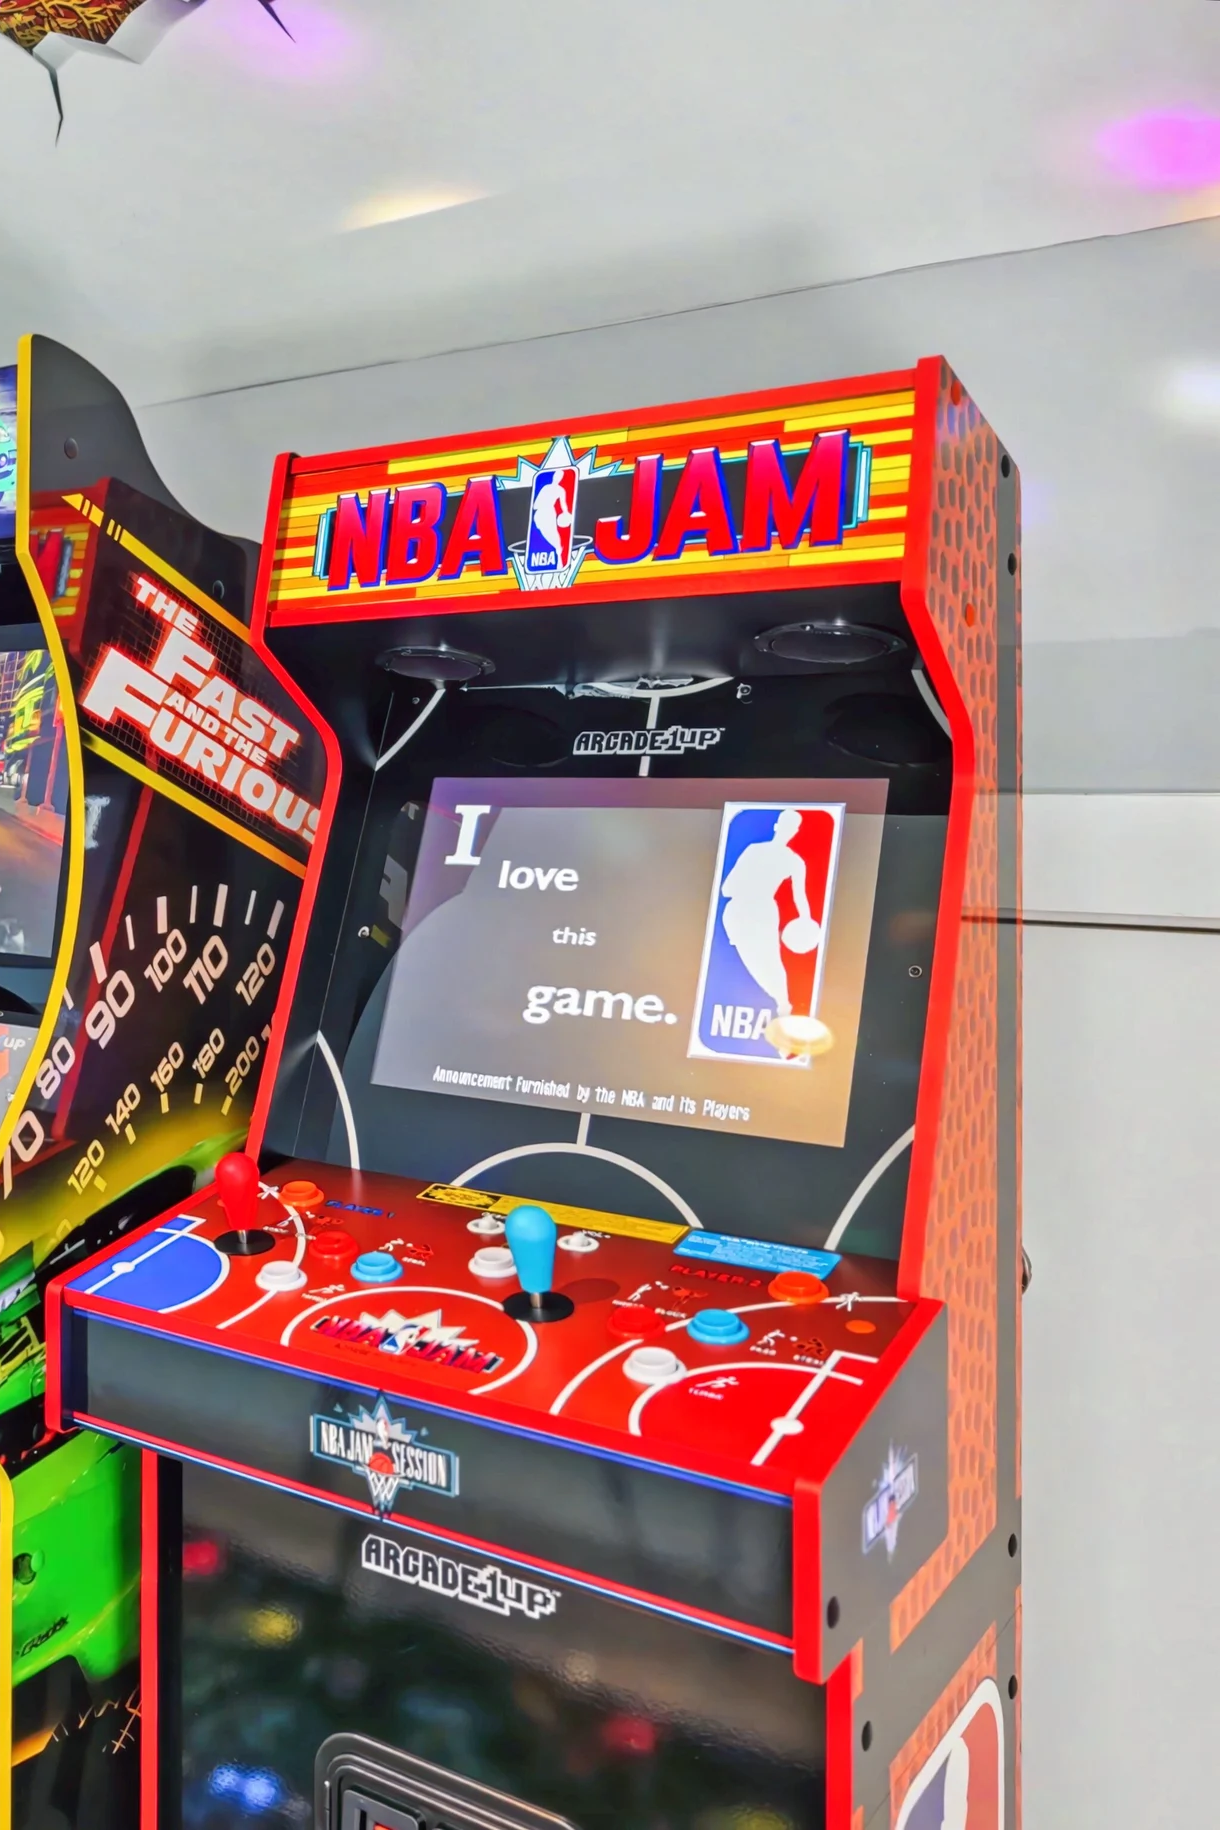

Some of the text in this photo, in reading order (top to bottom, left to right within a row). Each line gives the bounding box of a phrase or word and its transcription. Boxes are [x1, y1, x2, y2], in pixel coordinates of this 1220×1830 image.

[327, 429, 851, 592] NBA JAM
[531, 551, 557, 567] NBA
[133, 576, 200, 637] THE
[152, 628, 300, 758] FAST
[164, 690, 267, 767] AND THE
[444, 804, 490, 865] I
[498, 861, 579, 891] love
[143, 928, 188, 992] 100
[552, 926, 597, 946] this
[182, 935, 229, 1005] 110
[235, 942, 276, 1006] 120
[85, 969, 135, 1049] 90
[522, 985, 678, 1025] game.
[710, 1004, 772, 1040] NBA
[35, 1036, 76, 1100] 80
[150, 1042, 185, 1093] 160
[192, 1028, 225, 1079] 180
[224, 1036, 260, 1097] 200
[105, 1082, 141, 1135] 140
[433, 1065, 513, 1092] Announcement
[515, 1075, 570, 1099] Furnished
[576, 1084, 590, 1103] by
[595, 1086, 615, 1105] the
[621, 1089, 645, 1108] NBA
[652, 1094, 674, 1112] and
[702, 1099, 751, 1122] Players
[67, 1139, 105, 1196] 120
[670, 1264, 745, 1284] PLAYER
[321, 1421, 447, 1488] NBA JAM SESSION
[362, 1534, 556, 1619] ARCADE1UP
